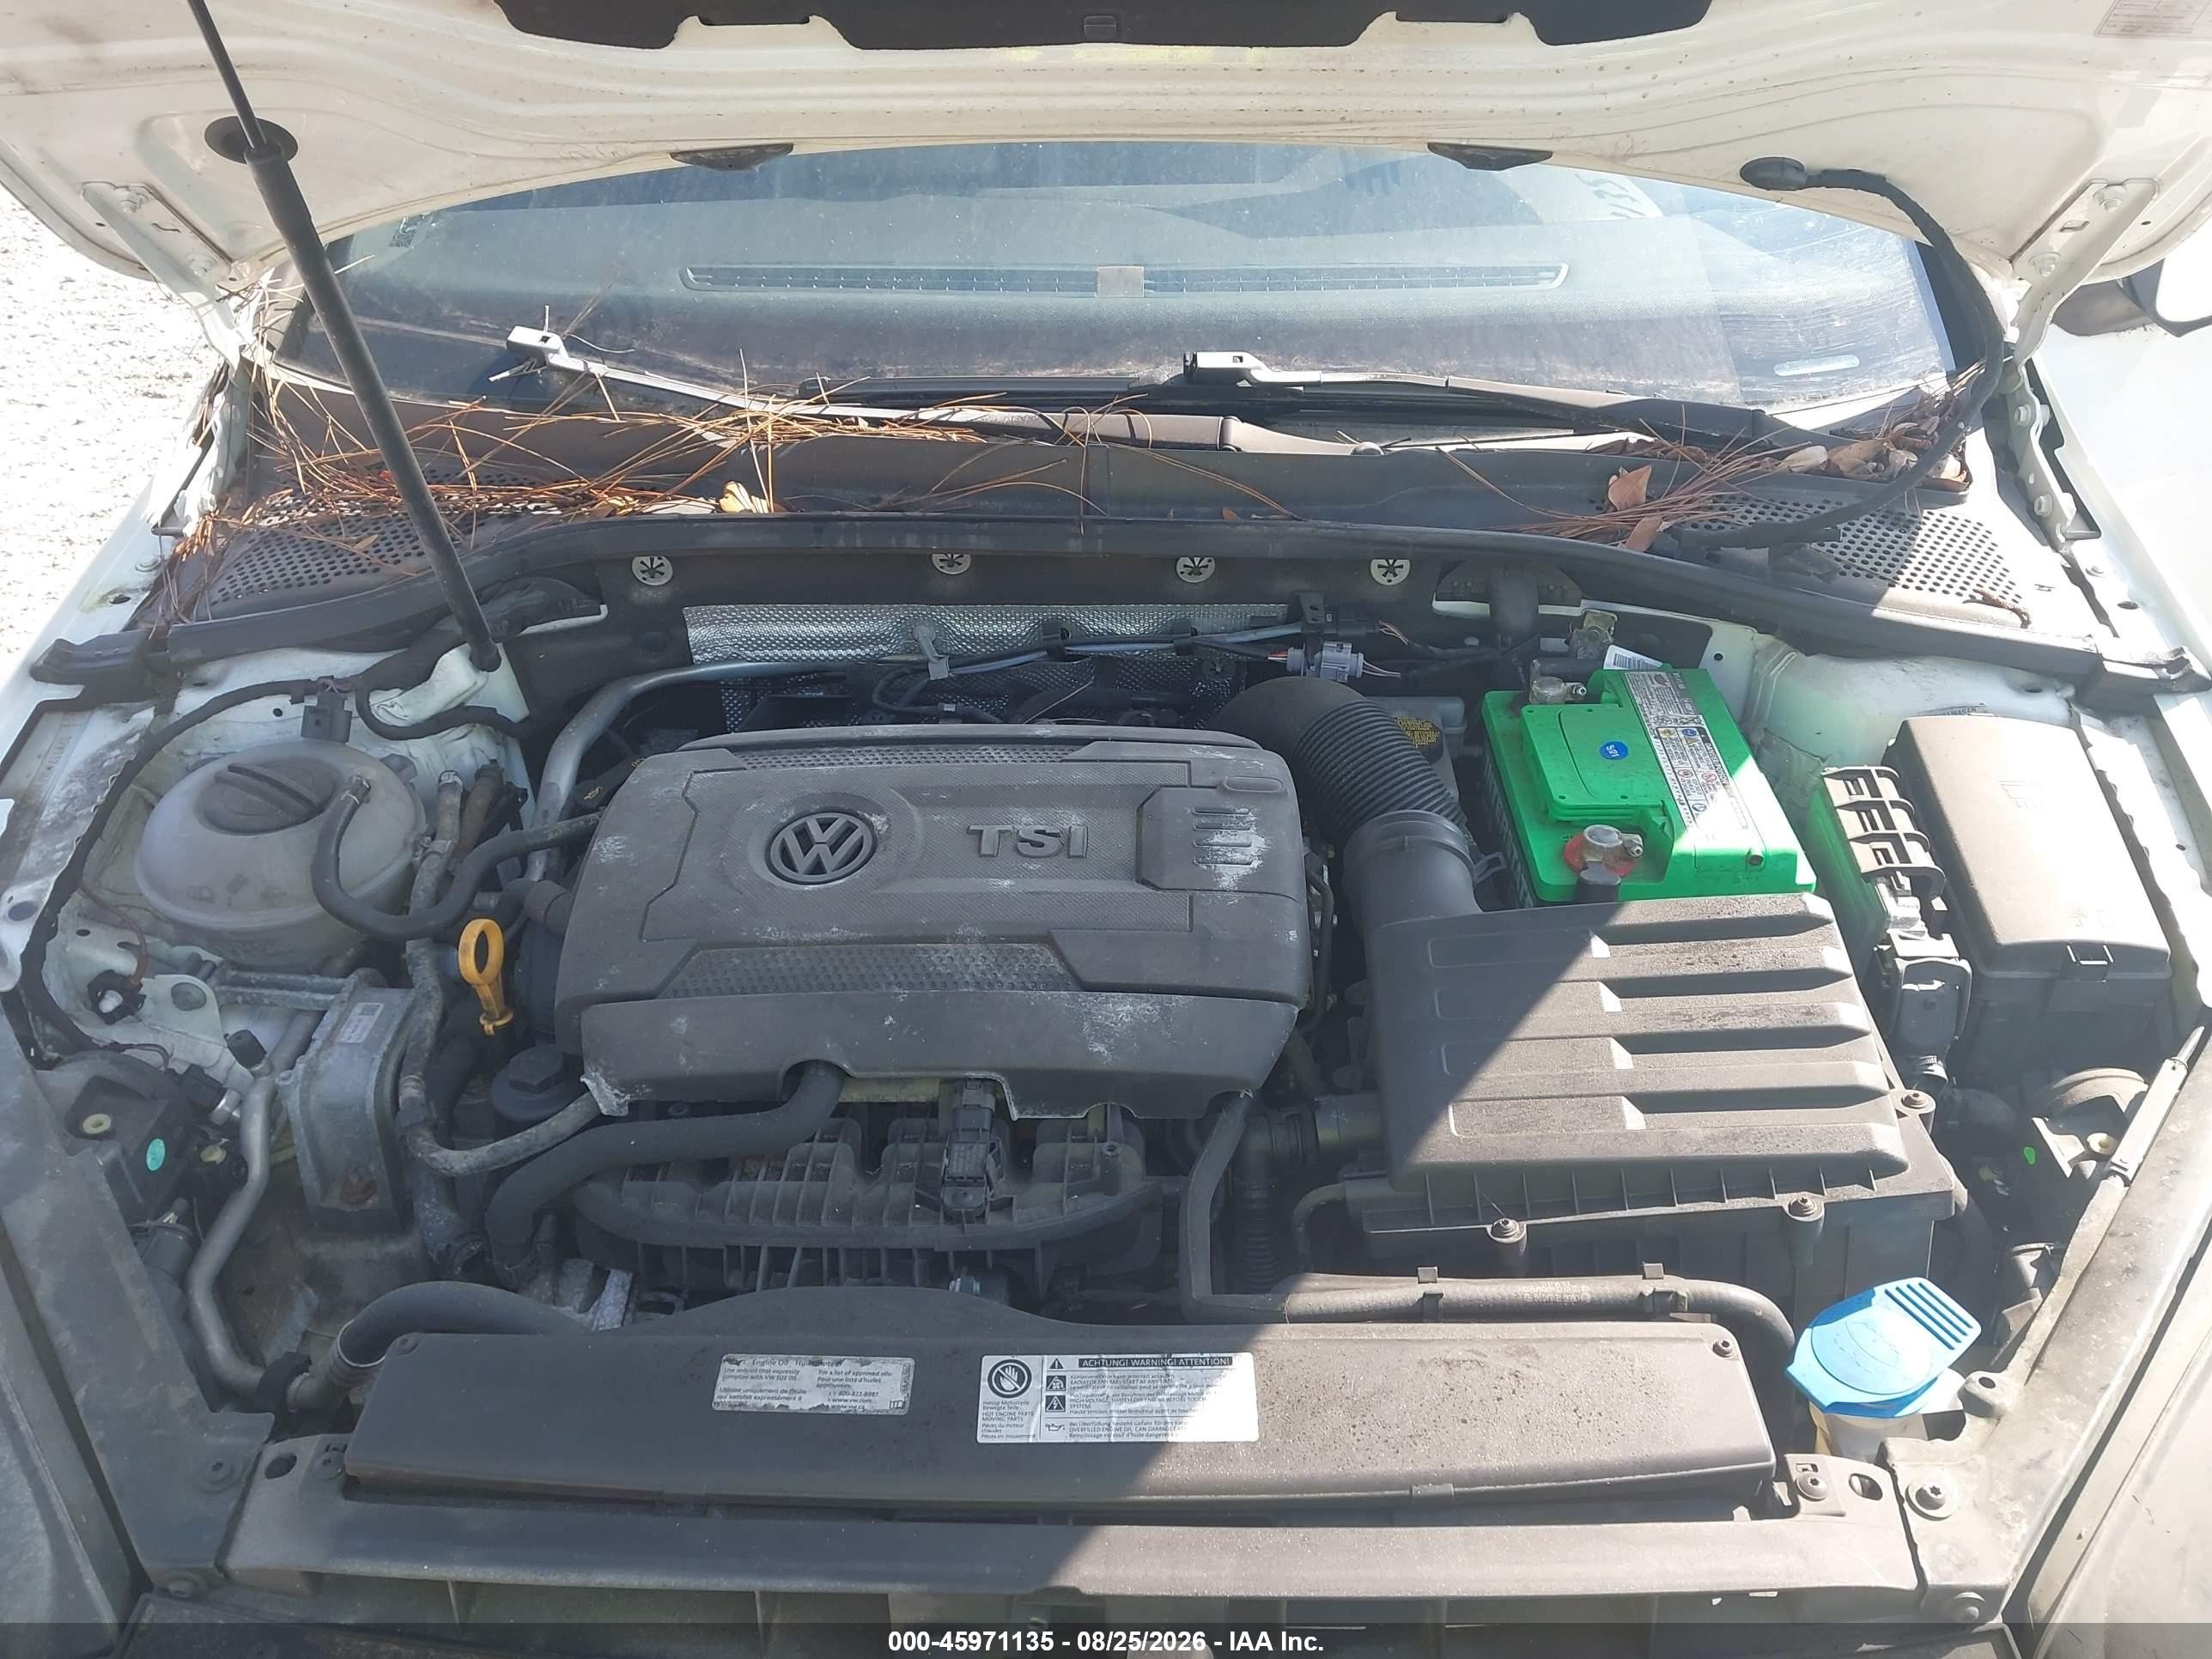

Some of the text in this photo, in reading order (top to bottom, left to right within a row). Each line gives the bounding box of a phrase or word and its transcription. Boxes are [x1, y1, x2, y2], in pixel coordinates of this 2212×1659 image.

[767, 811, 877, 884] VW
[967, 823, 1088, 858] TSI
[1082, 1358, 1128, 1367] ACHTUNG!
[1178, 1358, 1229, 1366] ATTENTION!
